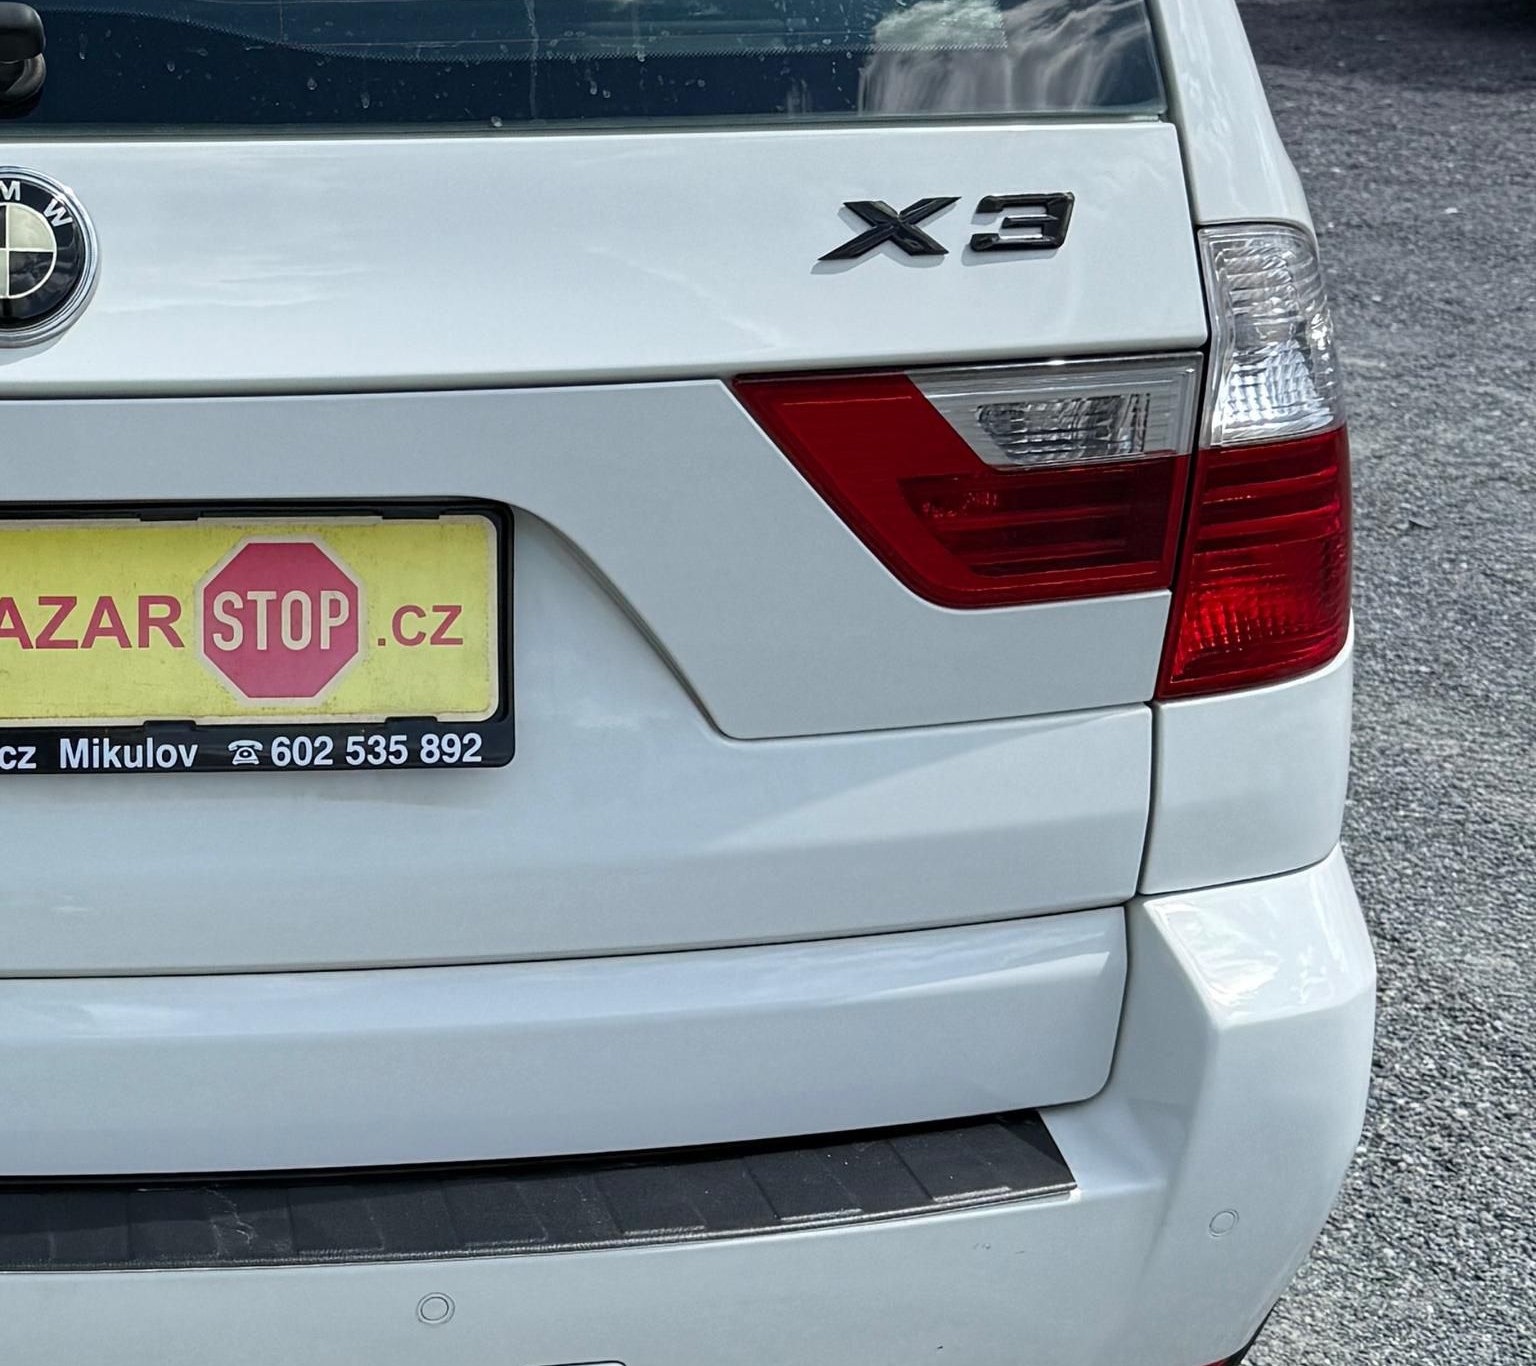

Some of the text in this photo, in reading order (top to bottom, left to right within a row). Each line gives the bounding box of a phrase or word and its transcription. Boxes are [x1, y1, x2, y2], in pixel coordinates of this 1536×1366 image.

[817, 191, 1076, 261] X3
[59, 737, 199, 769] Mikulov
[270, 736, 334, 767] 602
[345, 734, 408, 766] 535
[419, 732, 482, 764] 892
